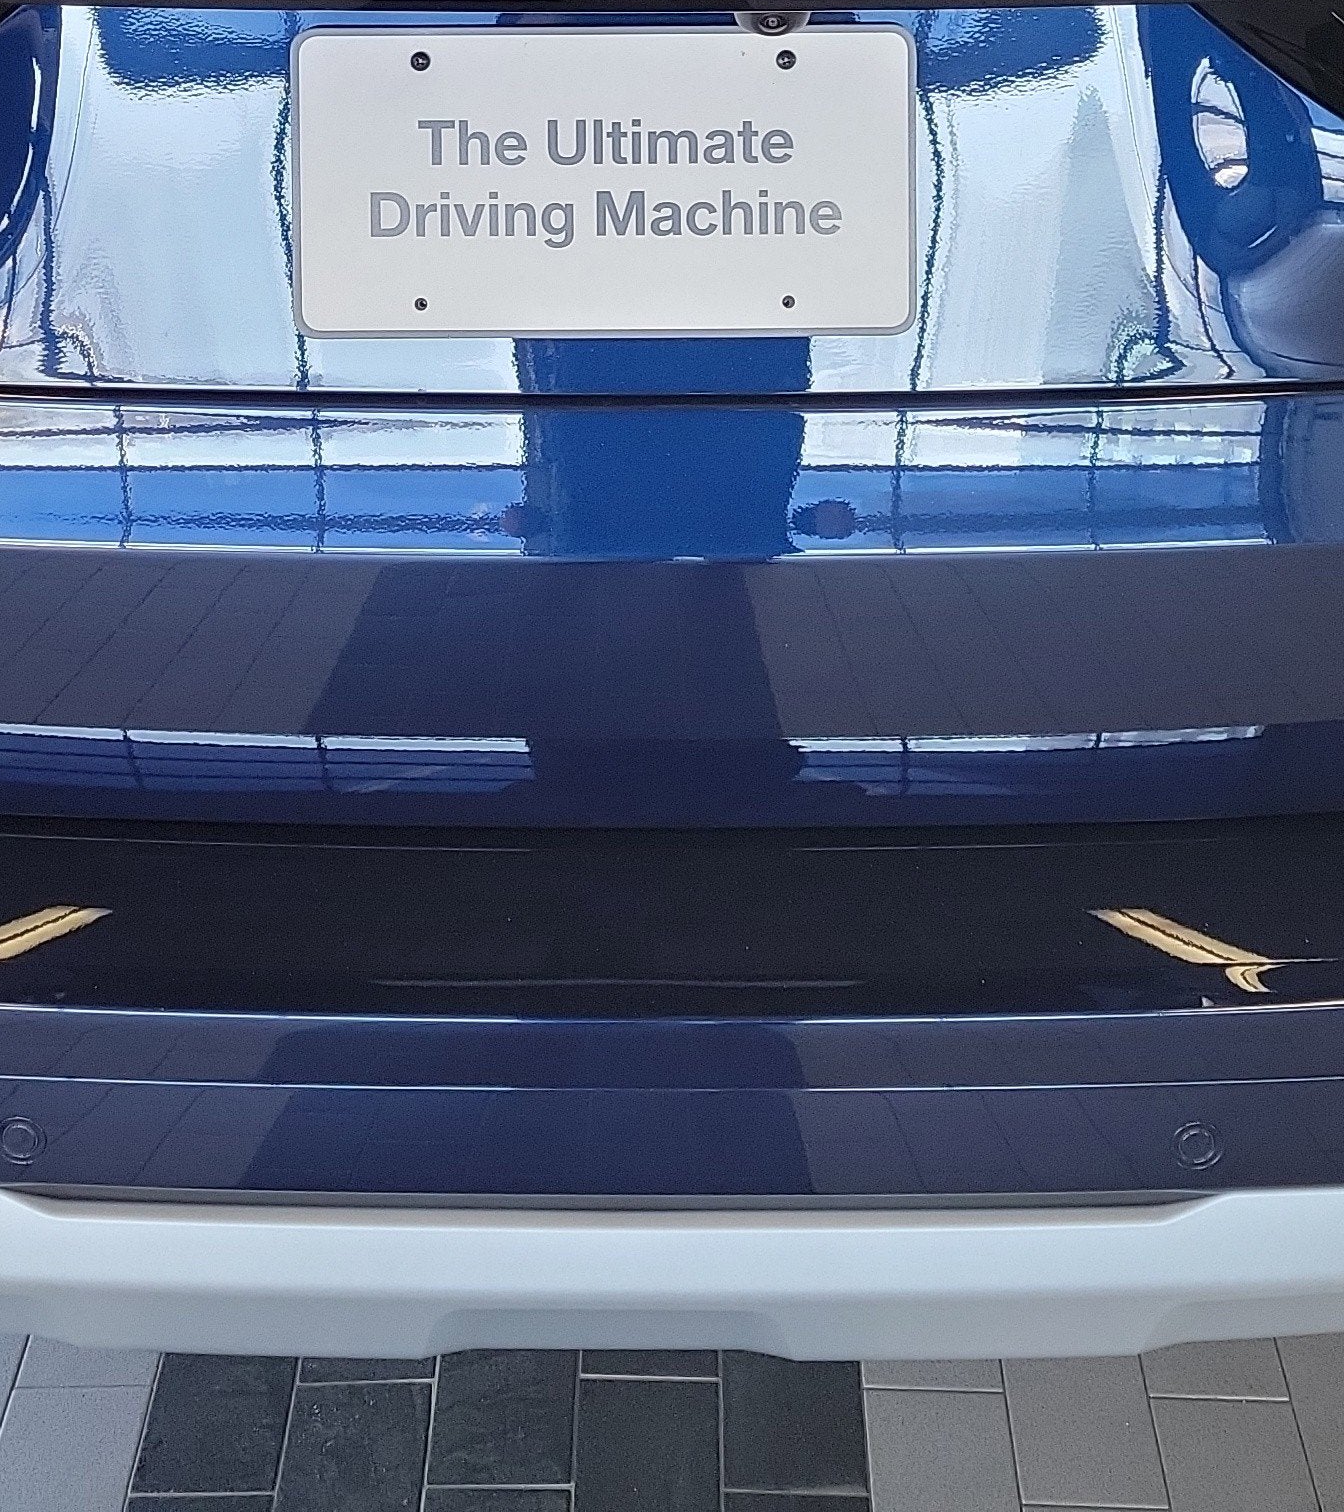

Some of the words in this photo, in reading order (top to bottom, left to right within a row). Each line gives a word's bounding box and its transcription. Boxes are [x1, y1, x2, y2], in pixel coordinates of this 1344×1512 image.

[417, 119, 529, 167] The
[546, 118, 795, 167] Ultimate
[369, 191, 575, 249] Driving
[596, 190, 843, 238] Machine
